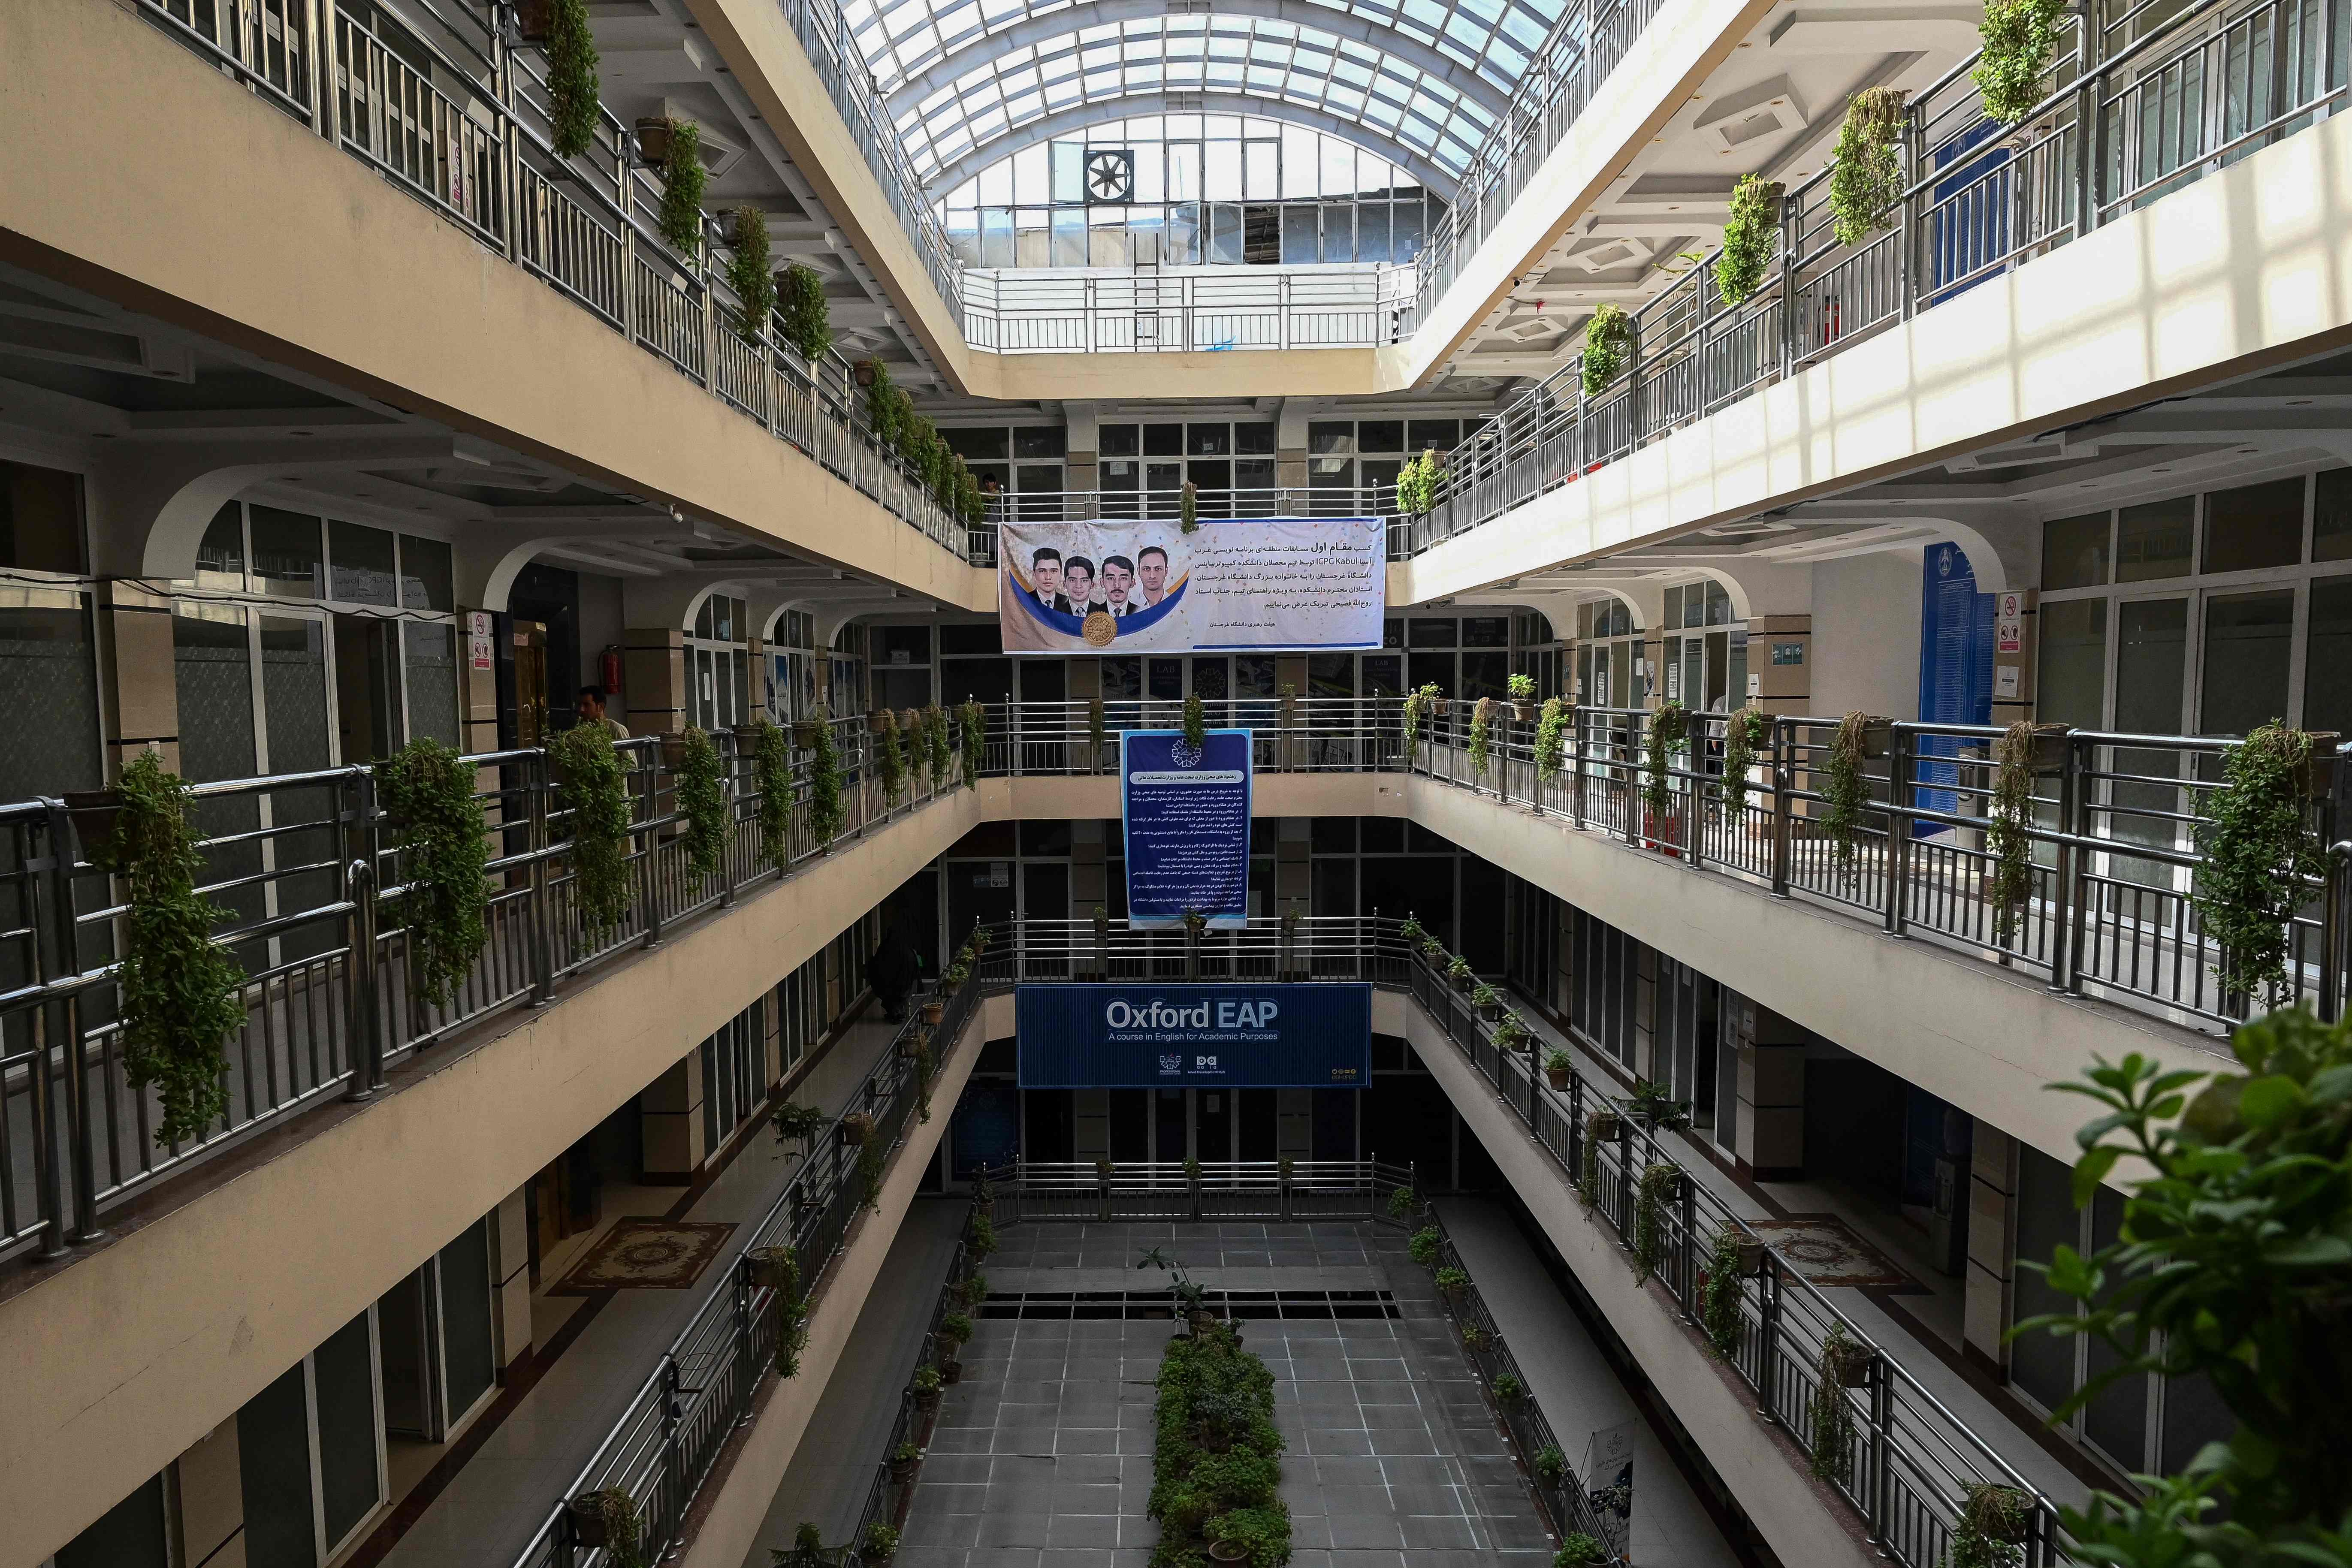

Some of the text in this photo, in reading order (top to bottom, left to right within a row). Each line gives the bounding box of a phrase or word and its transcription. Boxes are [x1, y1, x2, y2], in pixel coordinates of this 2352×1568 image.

[1311, 542, 1326, 553] اول
[1330, 542, 1352, 555] مقام
[1360, 557, 1372, 566] آسیا
[1107, 1001, 1277, 1028] Oxford EAP
[1156, 1033, 1184, 1041] English
[1241, 1033, 1277, 1041] Purposes
